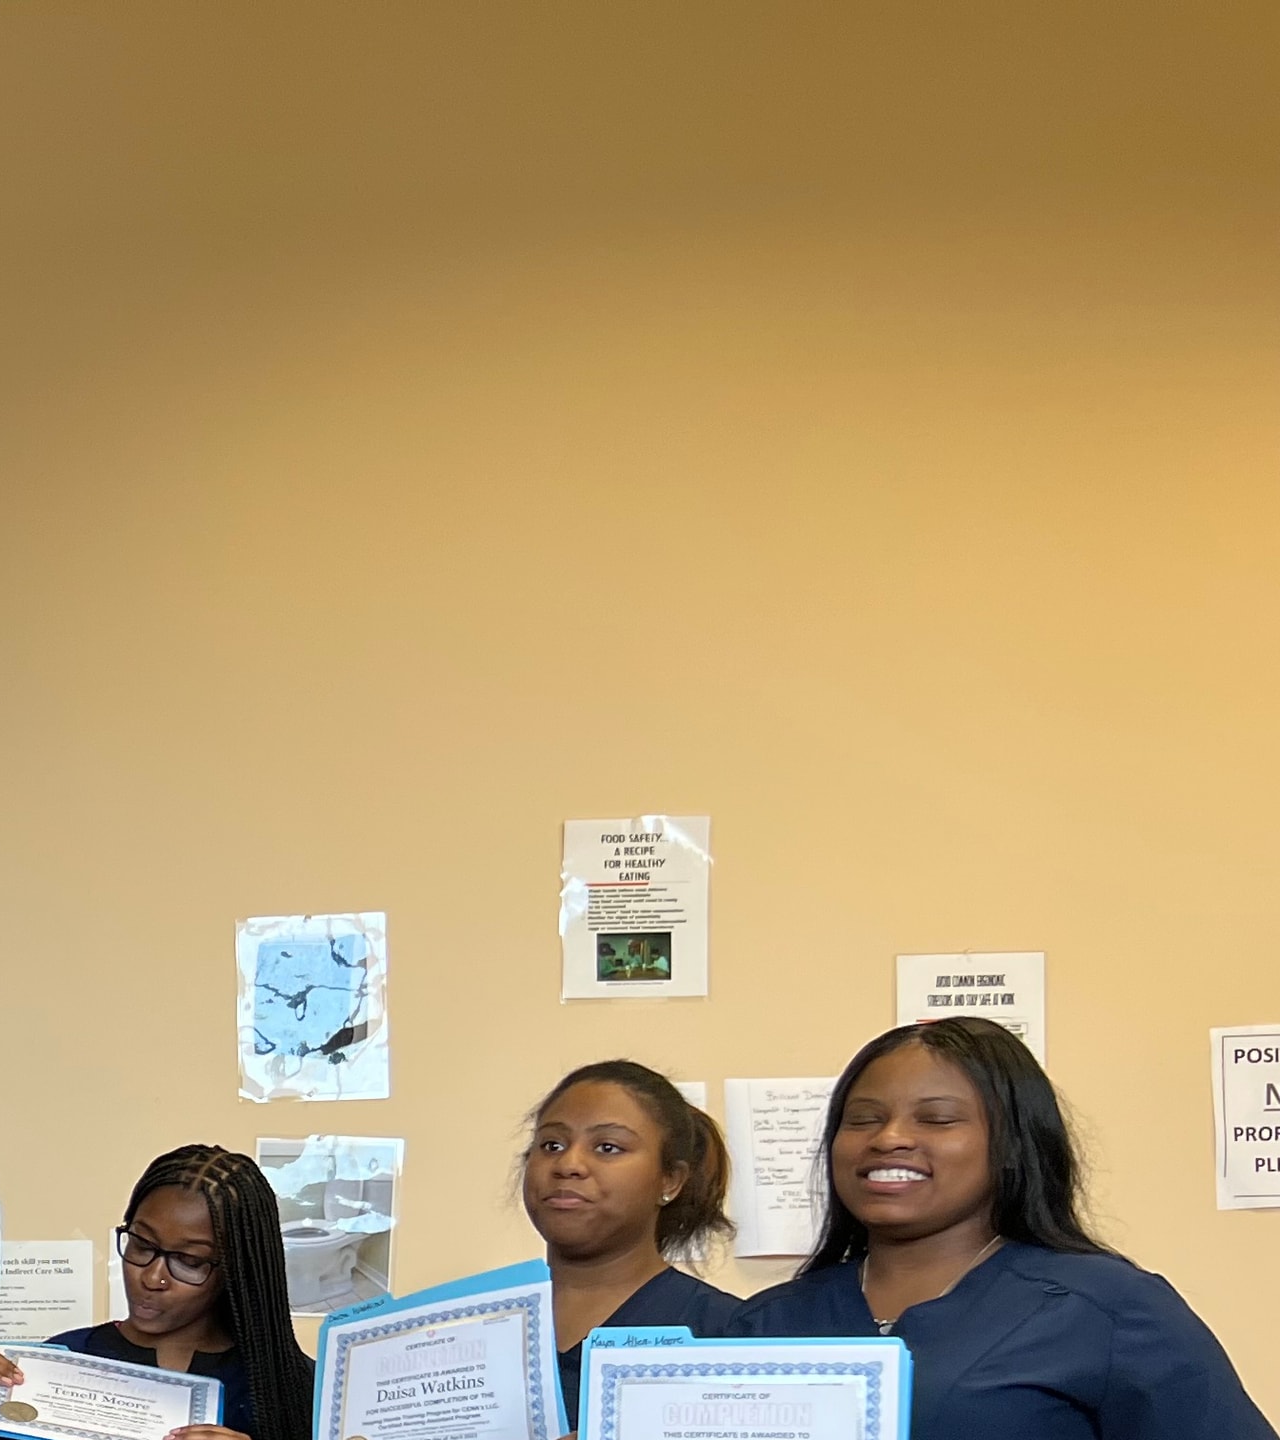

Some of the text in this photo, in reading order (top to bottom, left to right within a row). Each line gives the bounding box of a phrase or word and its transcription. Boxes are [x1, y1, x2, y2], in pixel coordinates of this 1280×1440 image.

[601, 834, 625, 843] FOOD
[614, 846, 655, 856] A RECIPE
[605, 859, 665, 868] FOR HEALTHY
[619, 872, 650, 881] EATING
[377, 1375, 484, 1403] Daisa Watkins
[52, 1386, 150, 1409] Tenell Moore
[663, 1403, 812, 1427] COMPLETION
